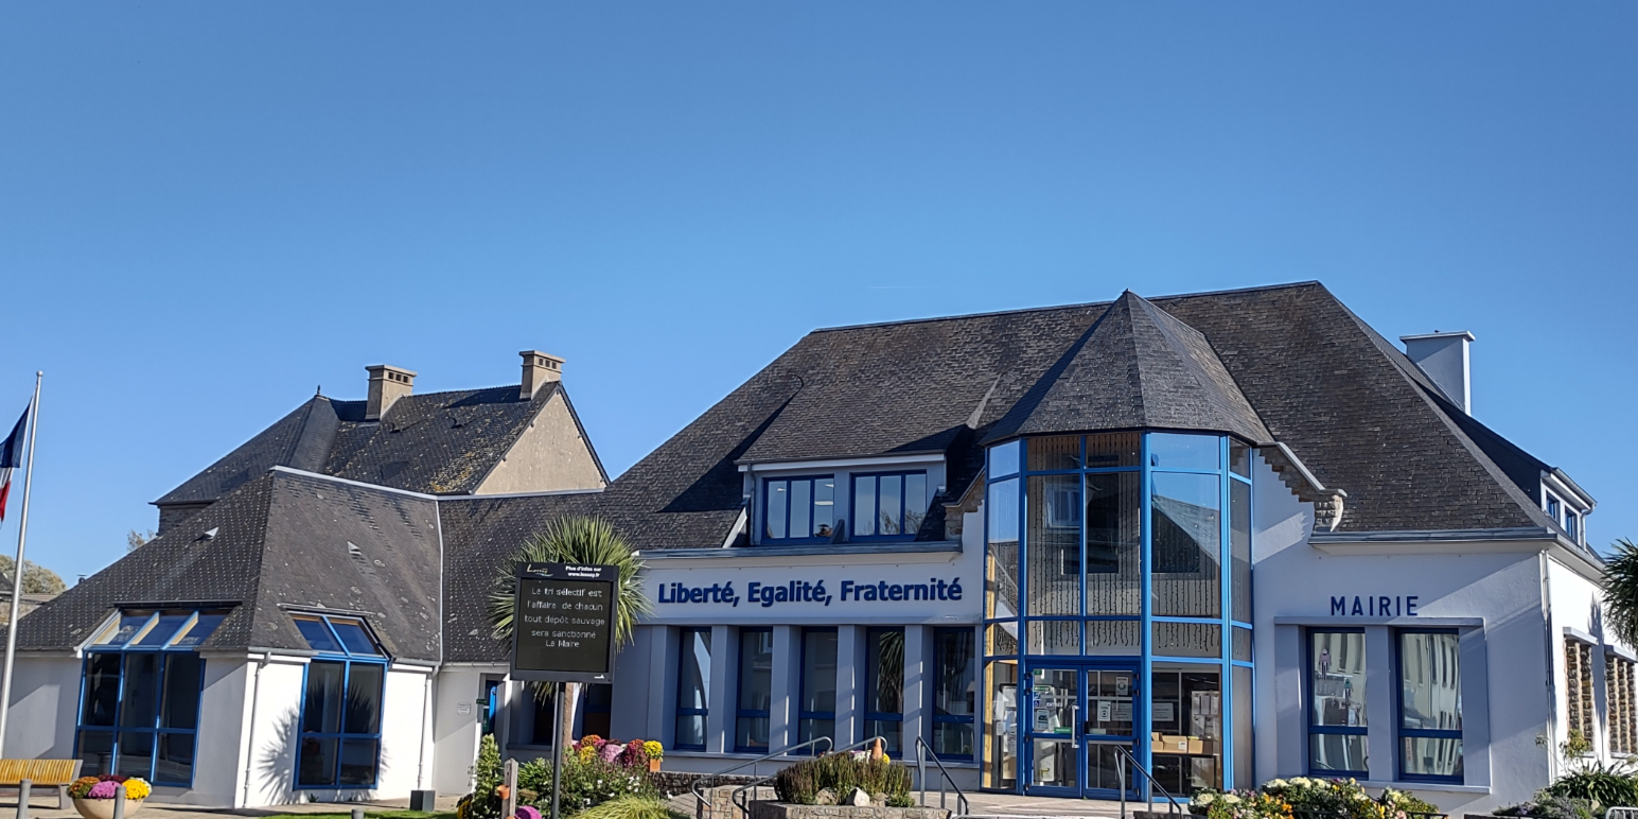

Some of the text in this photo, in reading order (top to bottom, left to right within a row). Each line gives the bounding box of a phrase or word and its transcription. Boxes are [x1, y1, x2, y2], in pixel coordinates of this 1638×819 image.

[658, 578, 962, 607] Liberté, Egalité, Fraternité
[1331, 596, 1418, 616] MAIRIE
[545, 616, 568, 624] dépôt
[572, 617, 605, 626] sauvage
